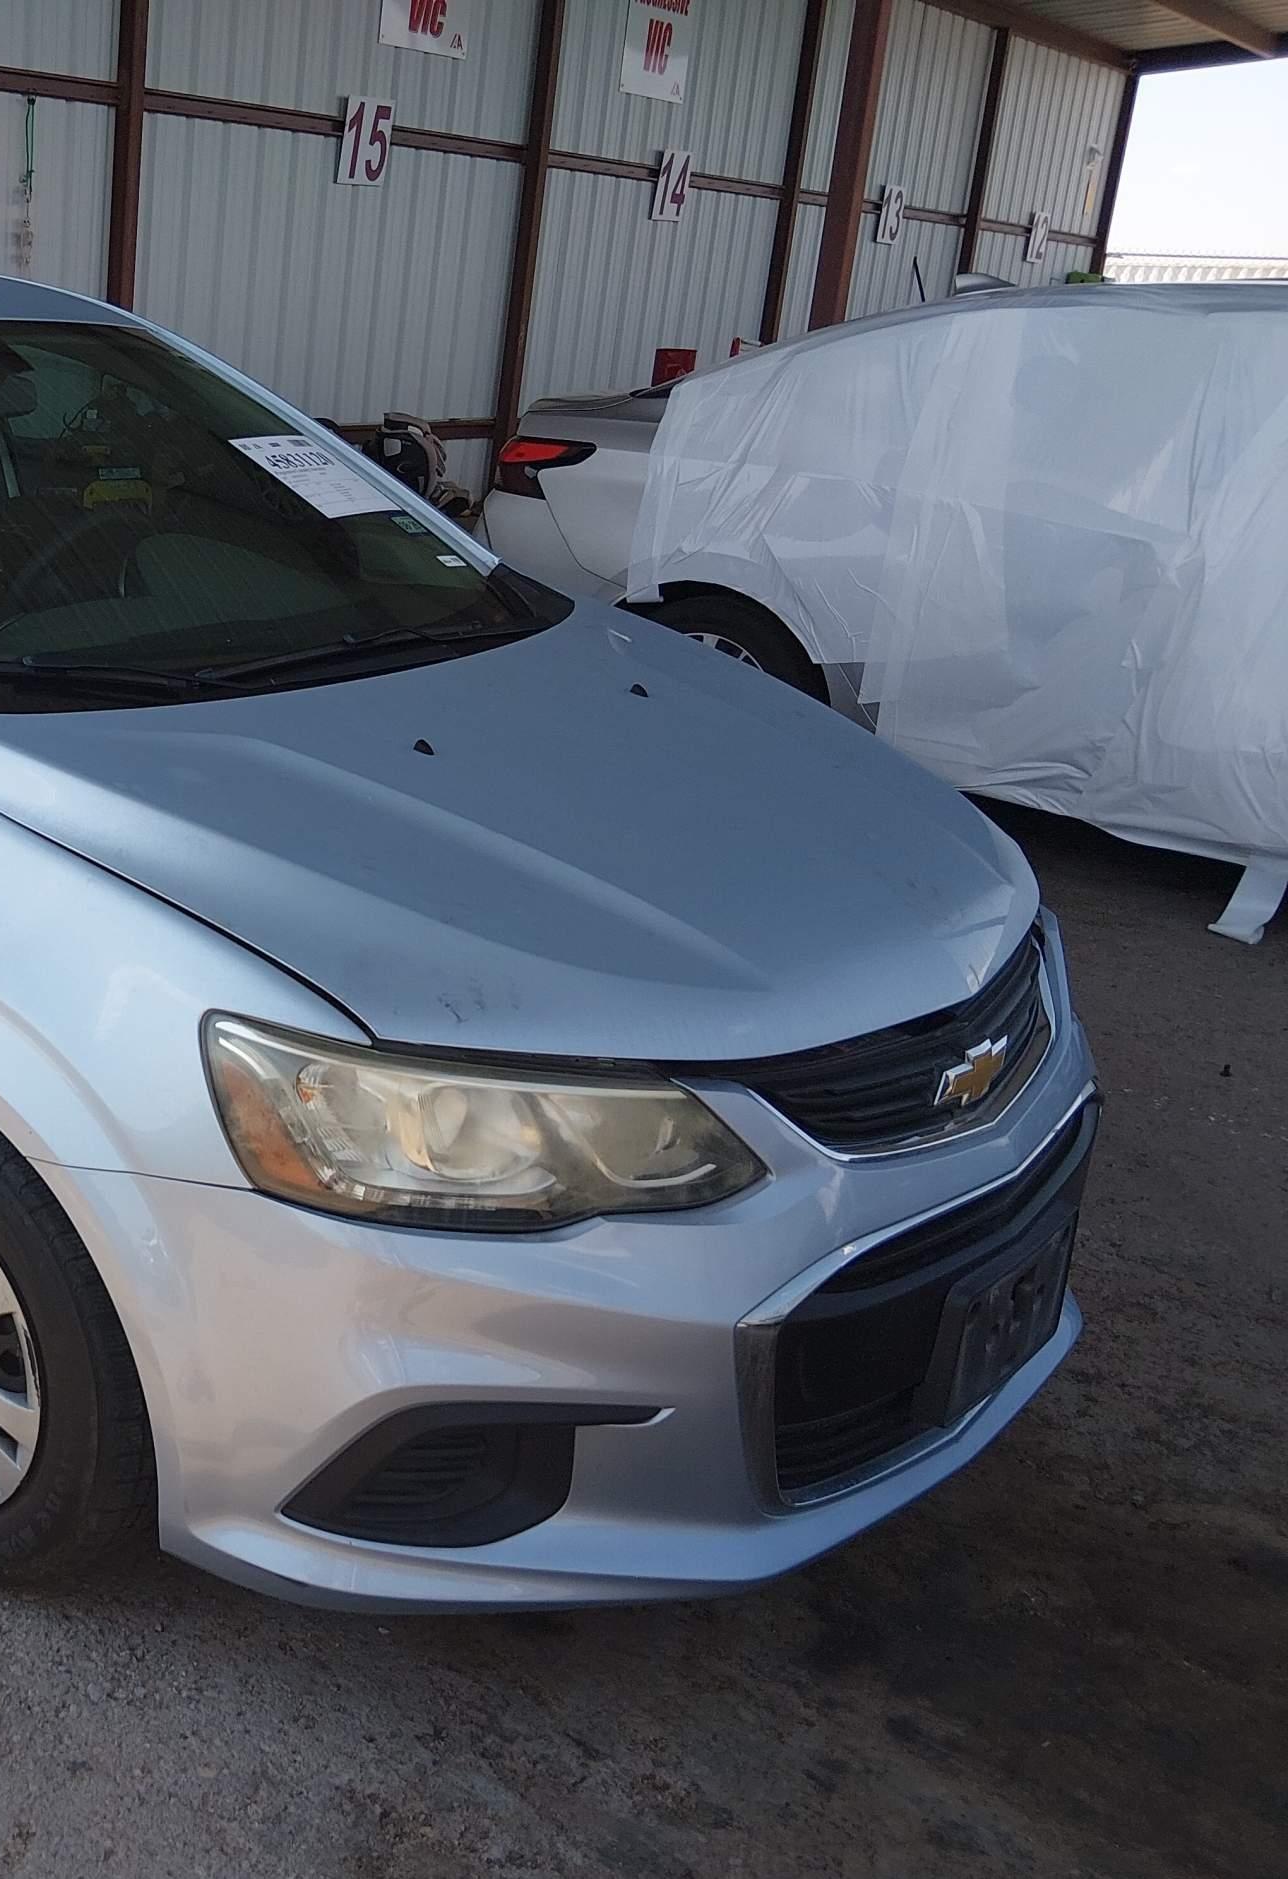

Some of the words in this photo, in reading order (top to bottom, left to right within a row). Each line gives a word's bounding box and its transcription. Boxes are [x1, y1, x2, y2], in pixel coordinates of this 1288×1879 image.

[348, 101, 392, 182] 15
[659, 152, 690, 217] 14
[881, 188, 903, 241] 13
[1030, 214, 1049, 260] 12
